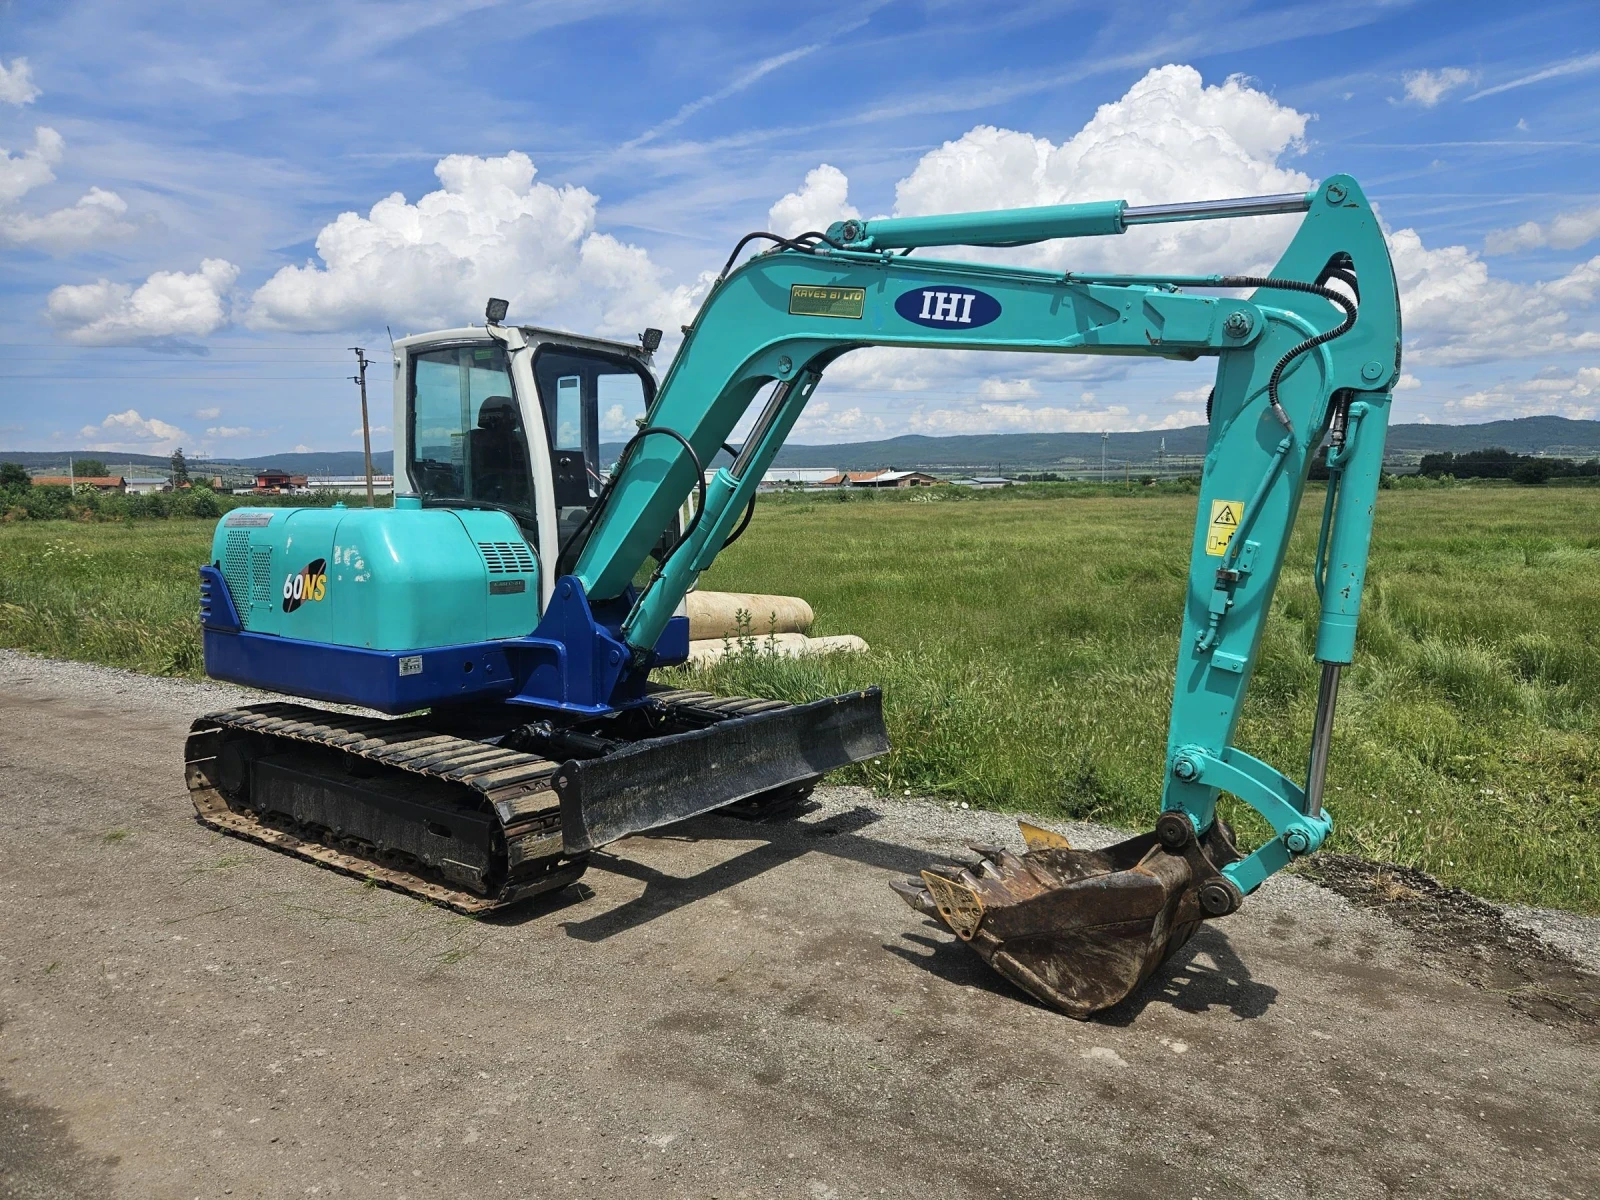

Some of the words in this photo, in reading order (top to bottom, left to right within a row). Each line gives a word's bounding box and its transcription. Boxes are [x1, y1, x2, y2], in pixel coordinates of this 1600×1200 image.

[794, 289, 827, 299] KAVES
[843, 292, 862, 301] LTD
[918, 291, 976, 323] IHI
[283, 573, 327, 601] 60NS
